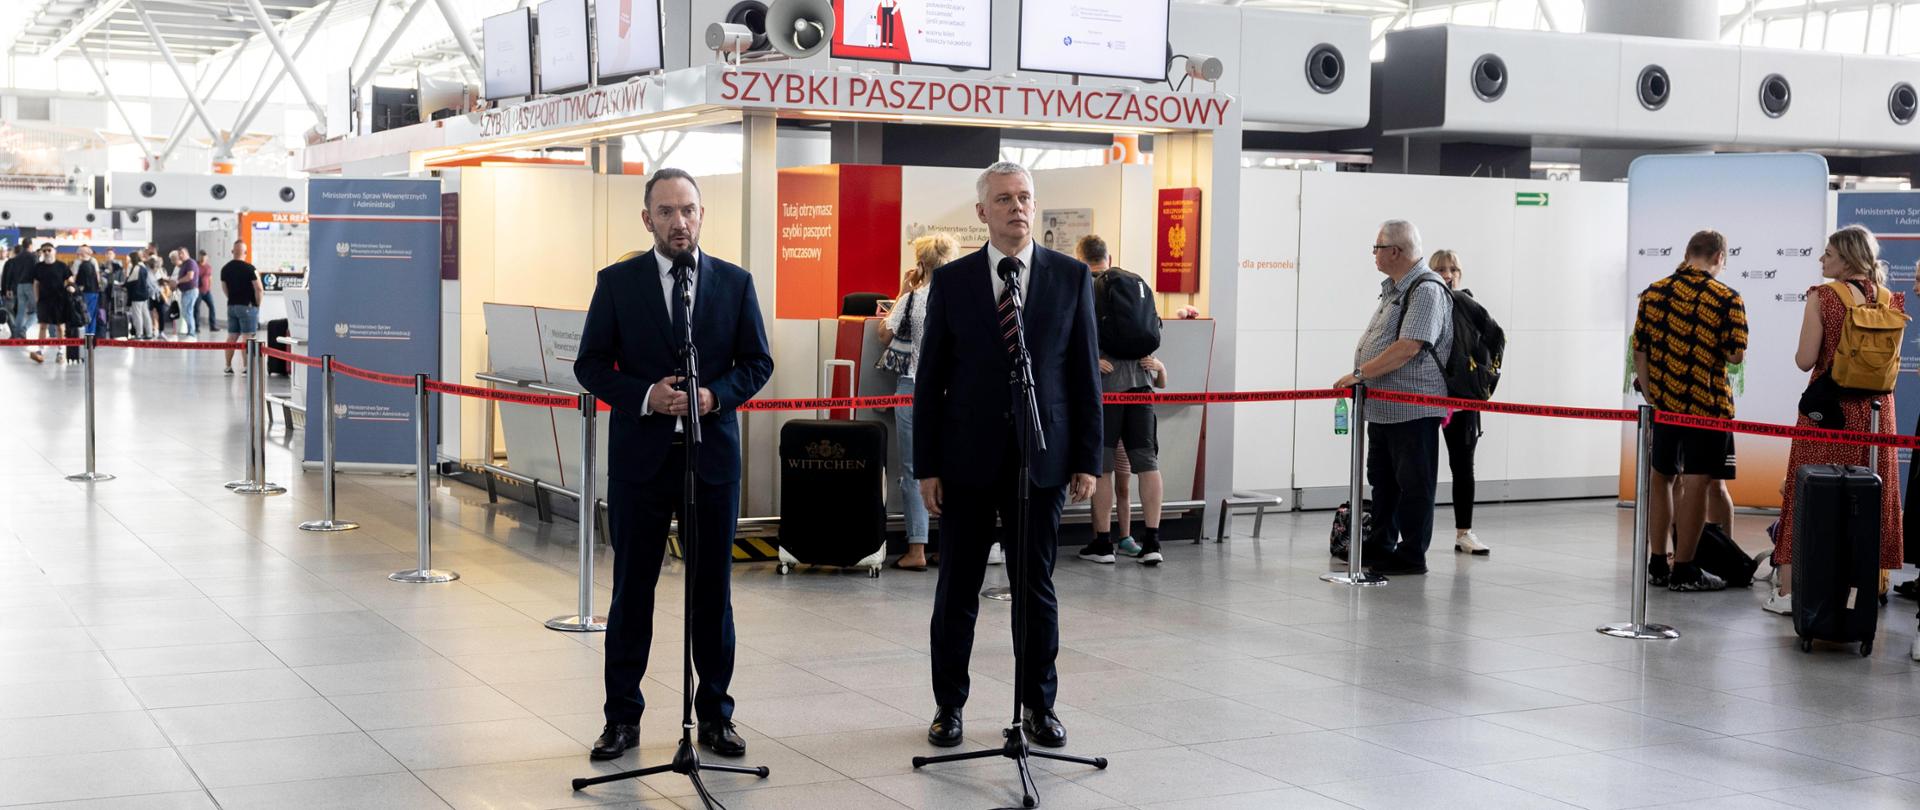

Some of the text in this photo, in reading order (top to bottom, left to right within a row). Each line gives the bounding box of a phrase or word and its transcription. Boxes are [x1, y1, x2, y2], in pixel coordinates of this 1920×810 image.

[721, 71, 1230, 126] SZYBKI PASZPORT TYMCZASOWY
[480, 82, 647, 137] SZYBKI PASZPORT TYMCZASOWY
[322, 192, 427, 201] Ministerstwo Spraw Wewnętrznych
[357, 201, 395, 209] Administracji
[782, 202, 832, 220] Tutaj otrzymasz
[1855, 208, 1906, 216] Ministerstwo
[272, 213, 289, 222] TAX
[782, 223, 832, 240] szybki paszport
[927, 224, 968, 232] Ministerstwo
[782, 245, 822, 261] tymczasowy
[1242, 259, 1293, 270] dla personelu
[1163, 393, 1206, 401] WARSZAWIE
[1250, 392, 1287, 400] FRYDERYK
[1287, 391, 1315, 399] CHOPIN
[1315, 390, 1345, 398] AIRPORT
[756, 400, 790, 409] CHOPINA
[795, 400, 803, 408] W
[804, 399, 852, 408] WARSZAWIE
[865, 398, 899, 406] WARSAW
[1369, 390, 1384, 398] PORT
[1385, 391, 1415, 401] LOTNICZY
[1427, 397, 1462, 406] FRYDERYKA
[1463, 400, 1491, 410] CHOPINA
[1502, 405, 1542, 414] WARSZAWIE
[1552, 408, 1584, 416] WARSAW
[1659, 413, 1680, 422] PORT
[1681, 415, 1720, 427] LOTNICZY
[1737, 423, 1787, 434] FRYDERYKA
[1788, 429, 1828, 438] CHOPINA
[1842, 433, 1896, 444] WARSZAWIE
[788, 459, 866, 470] WITTCHEN
